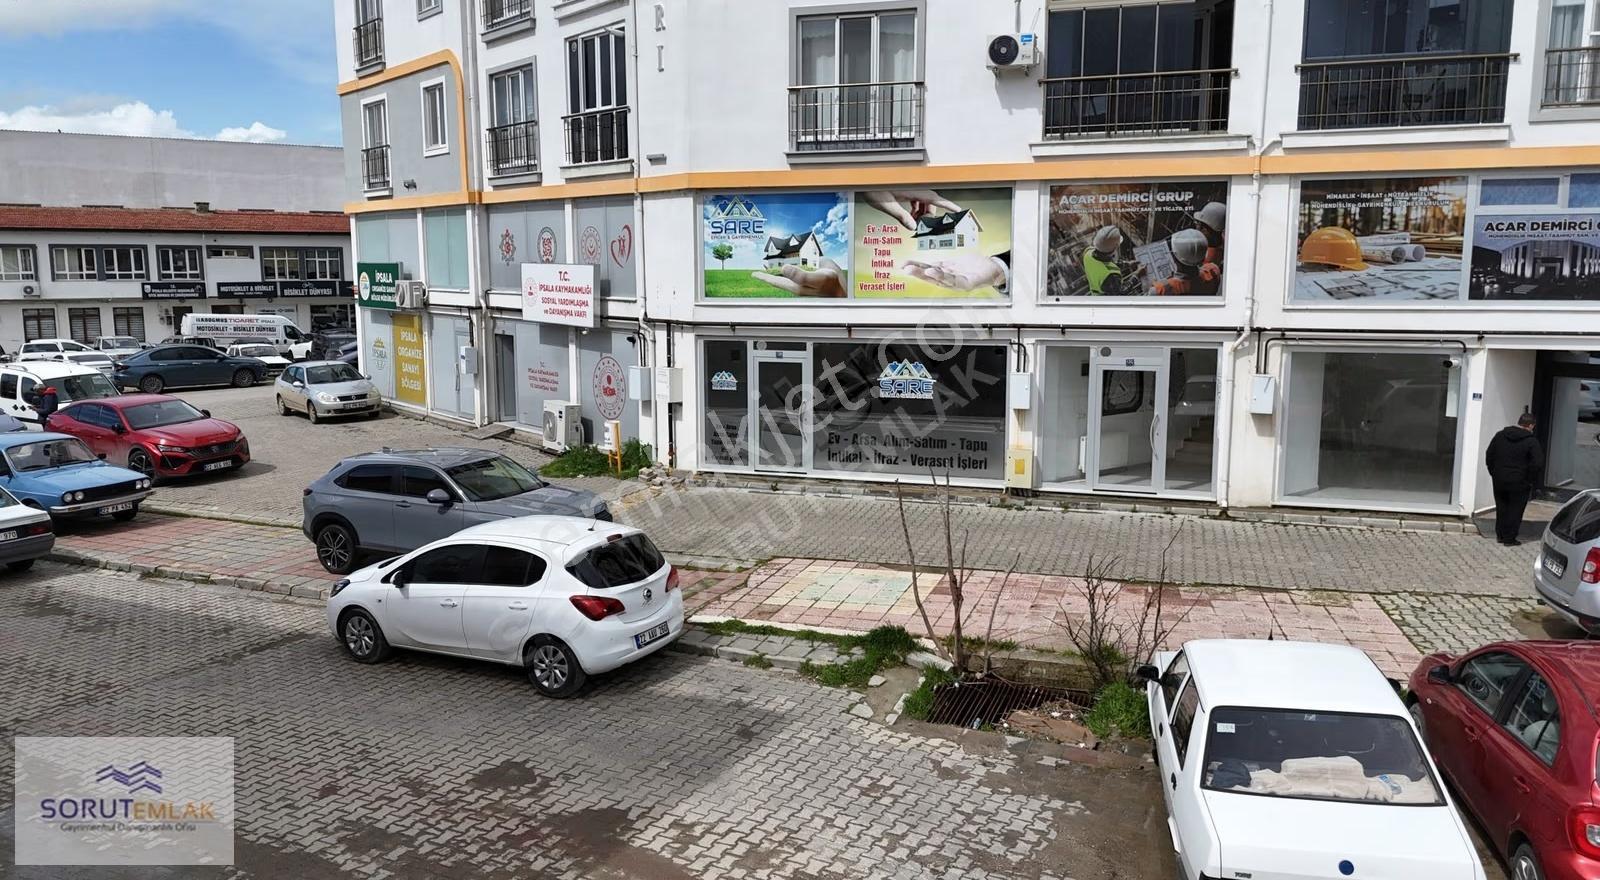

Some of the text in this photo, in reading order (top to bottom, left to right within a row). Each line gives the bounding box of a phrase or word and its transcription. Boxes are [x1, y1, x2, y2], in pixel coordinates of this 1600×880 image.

[1060, 190, 1194, 205] ACAR DEMİRCİ GRUP
[711, 220, 764, 234] SARE
[867, 225, 875, 233] Ev
[882, 225, 898, 233] Arsa
[1484, 222, 1527, 232] ACAR
[1530, 219, 1593, 231] DEMİRCİ
[863, 236, 902, 245] Alım-Satım
[874, 248, 891, 256] Tapu
[871, 259, 894, 268] İntikal
[375, 269, 393, 283] İPSALA
[558, 271, 570, 282] T.C.
[874, 271, 890, 279] İfraz
[283, 287, 332, 296] BİSİKLET DÜNYASI
[538, 282, 592, 295] İPSALA KAYMAKAMLIĞI
[859, 281, 905, 291] Veraset İşleri
[541, 297, 589, 308] SOSYAL YARDIMLAŞMA
[880, 380, 934, 394] SARE
[828, 432, 840, 444] Ev
[852, 433, 877, 446] Arsa
[959, 437, 988, 452] Tapu
[910, 453, 953, 468] Veraset
